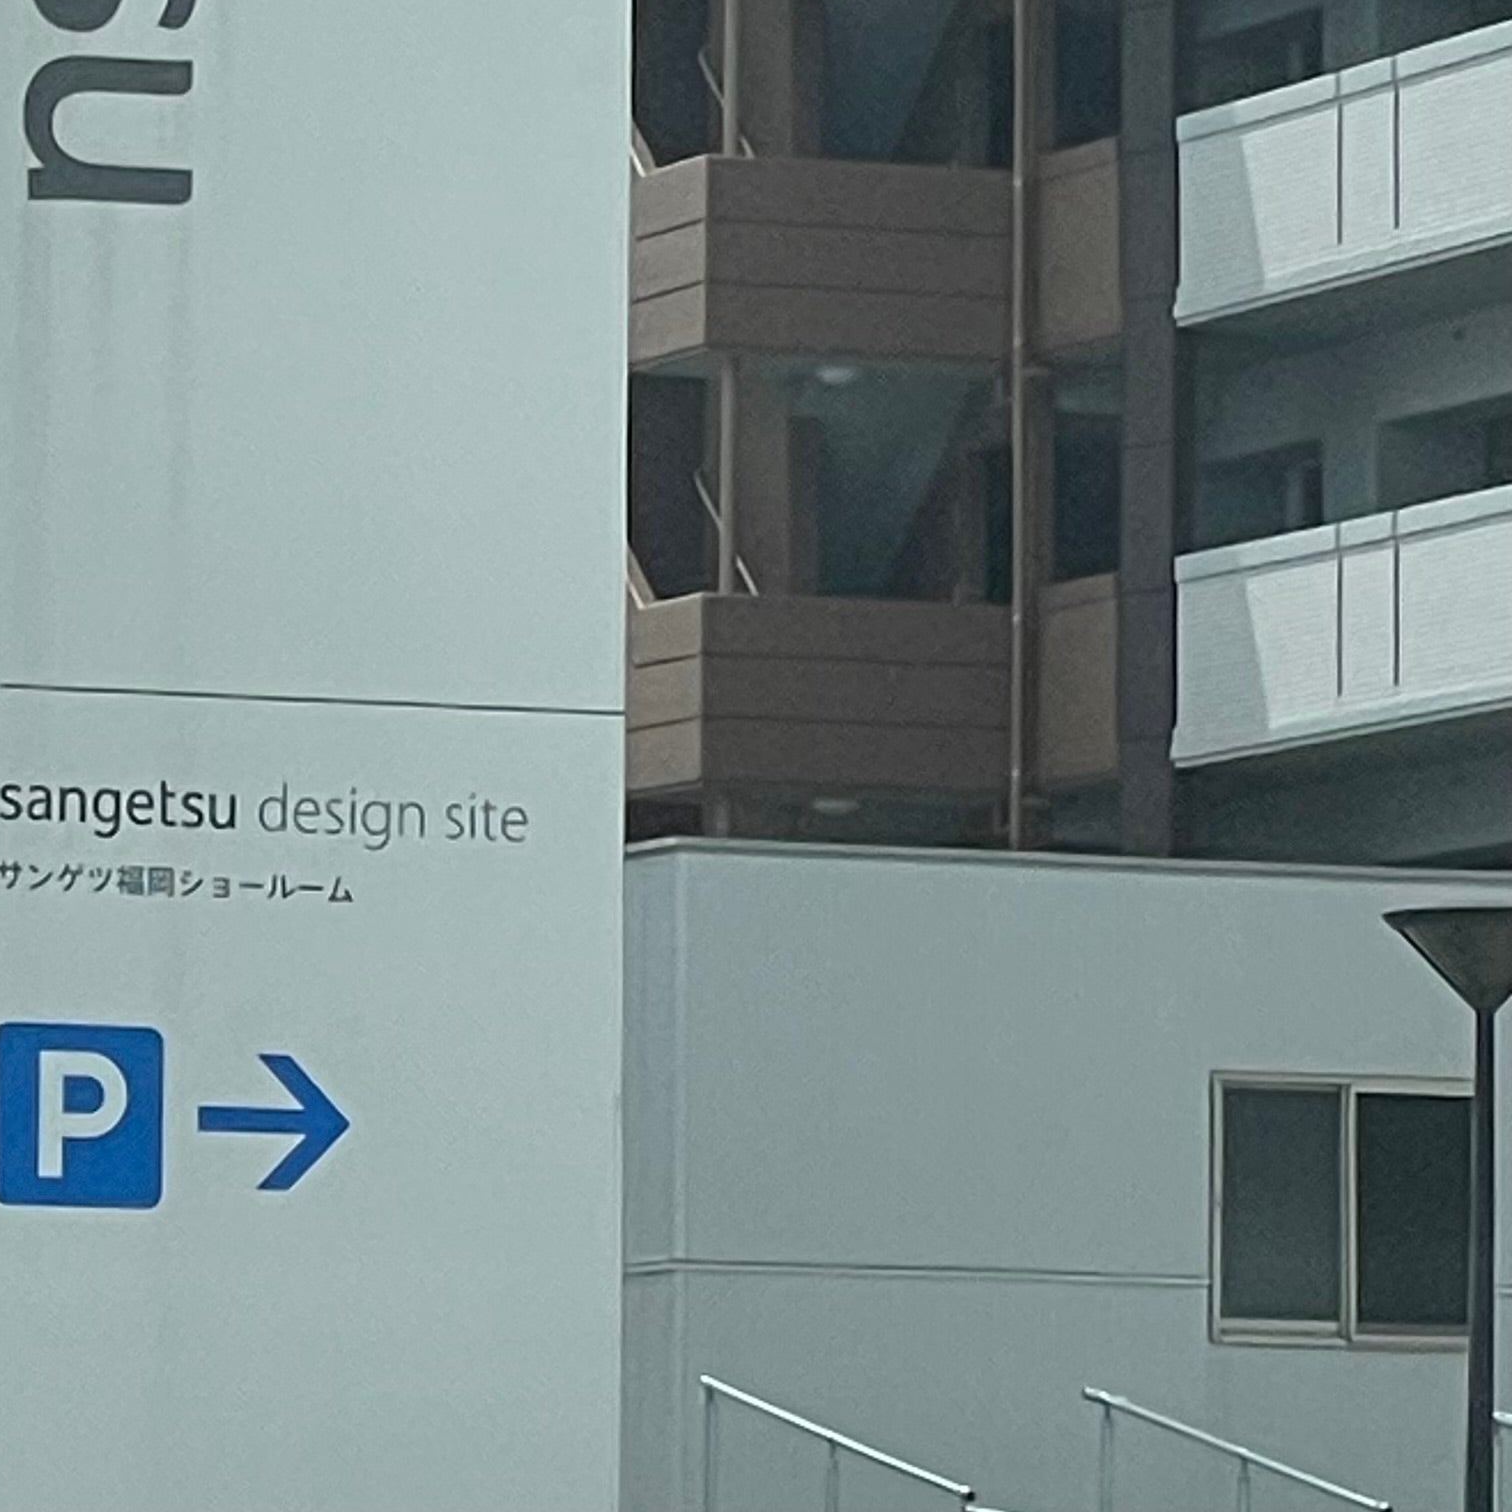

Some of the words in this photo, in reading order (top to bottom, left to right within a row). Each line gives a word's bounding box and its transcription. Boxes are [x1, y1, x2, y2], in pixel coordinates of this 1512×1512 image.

[257, 782, 426, 851] design
[444, 792, 530, 843] site
[37, 1049, 129, 1179] P
